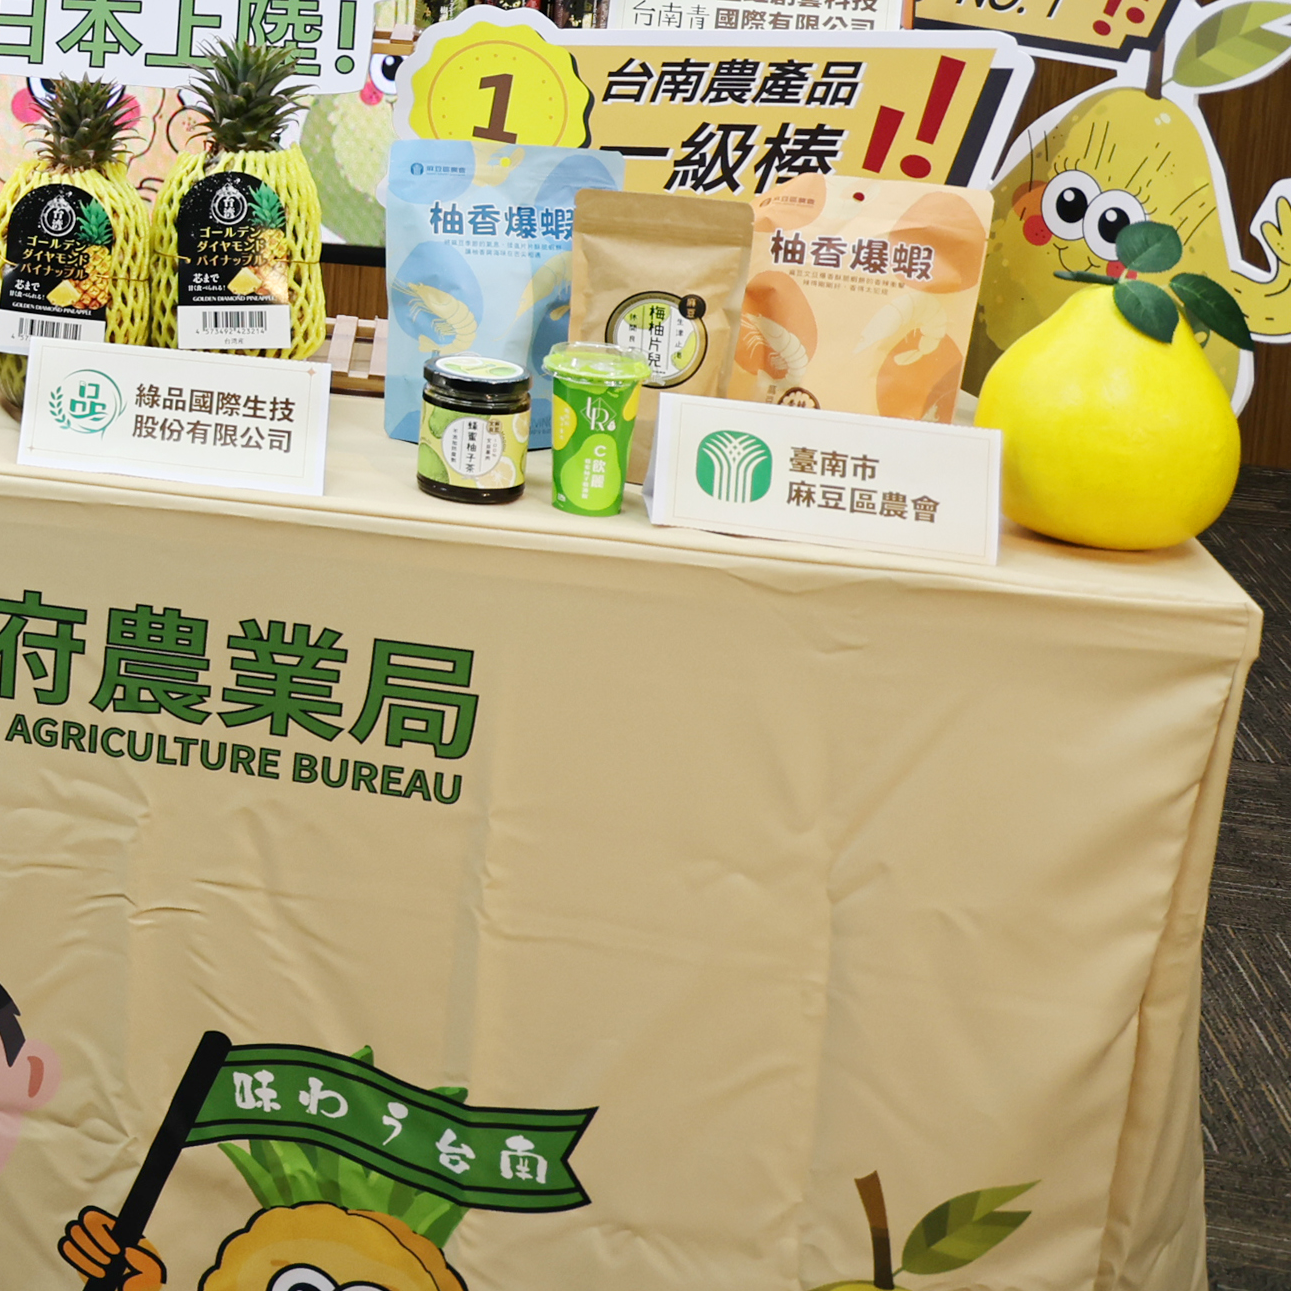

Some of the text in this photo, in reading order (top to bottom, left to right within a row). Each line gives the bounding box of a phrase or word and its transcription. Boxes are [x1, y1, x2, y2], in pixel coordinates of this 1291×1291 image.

[602, 56, 867, 109] 台南農產品
[471, 72, 519, 146] 1
[598, 121, 848, 196] 一級棒
[199, 226, 262, 239] ゴールデン
[429, 201, 575, 241] 柚香爆蝦
[22, 249, 89, 266] ダイヤモンド
[27, 235, 87, 251] ゴールデン
[196, 241, 264, 253] ダイヤモンド
[196, 254, 266, 267] パイナップル
[771, 229, 934, 281] 柚香爆蝦
[14, 279, 40, 291] 芯まで
[20, 263, 87, 279] パイナップル
[192, 273, 220, 283] 芯まで
[12, 301, 35, 309] GOLDEN
[35, 304, 64, 313] DIAMOND
[135, 383, 295, 423] 綠品國際生技
[132, 414, 293, 453] 股份有限公司
[789, 446, 880, 482] 臺南市
[786, 480, 941, 524] 麻豆區農會
[4, 712, 283, 782] AGRICULTURE
[289, 751, 463, 806] BUREAU
[233, 1070, 550, 1186] 味わう台南
